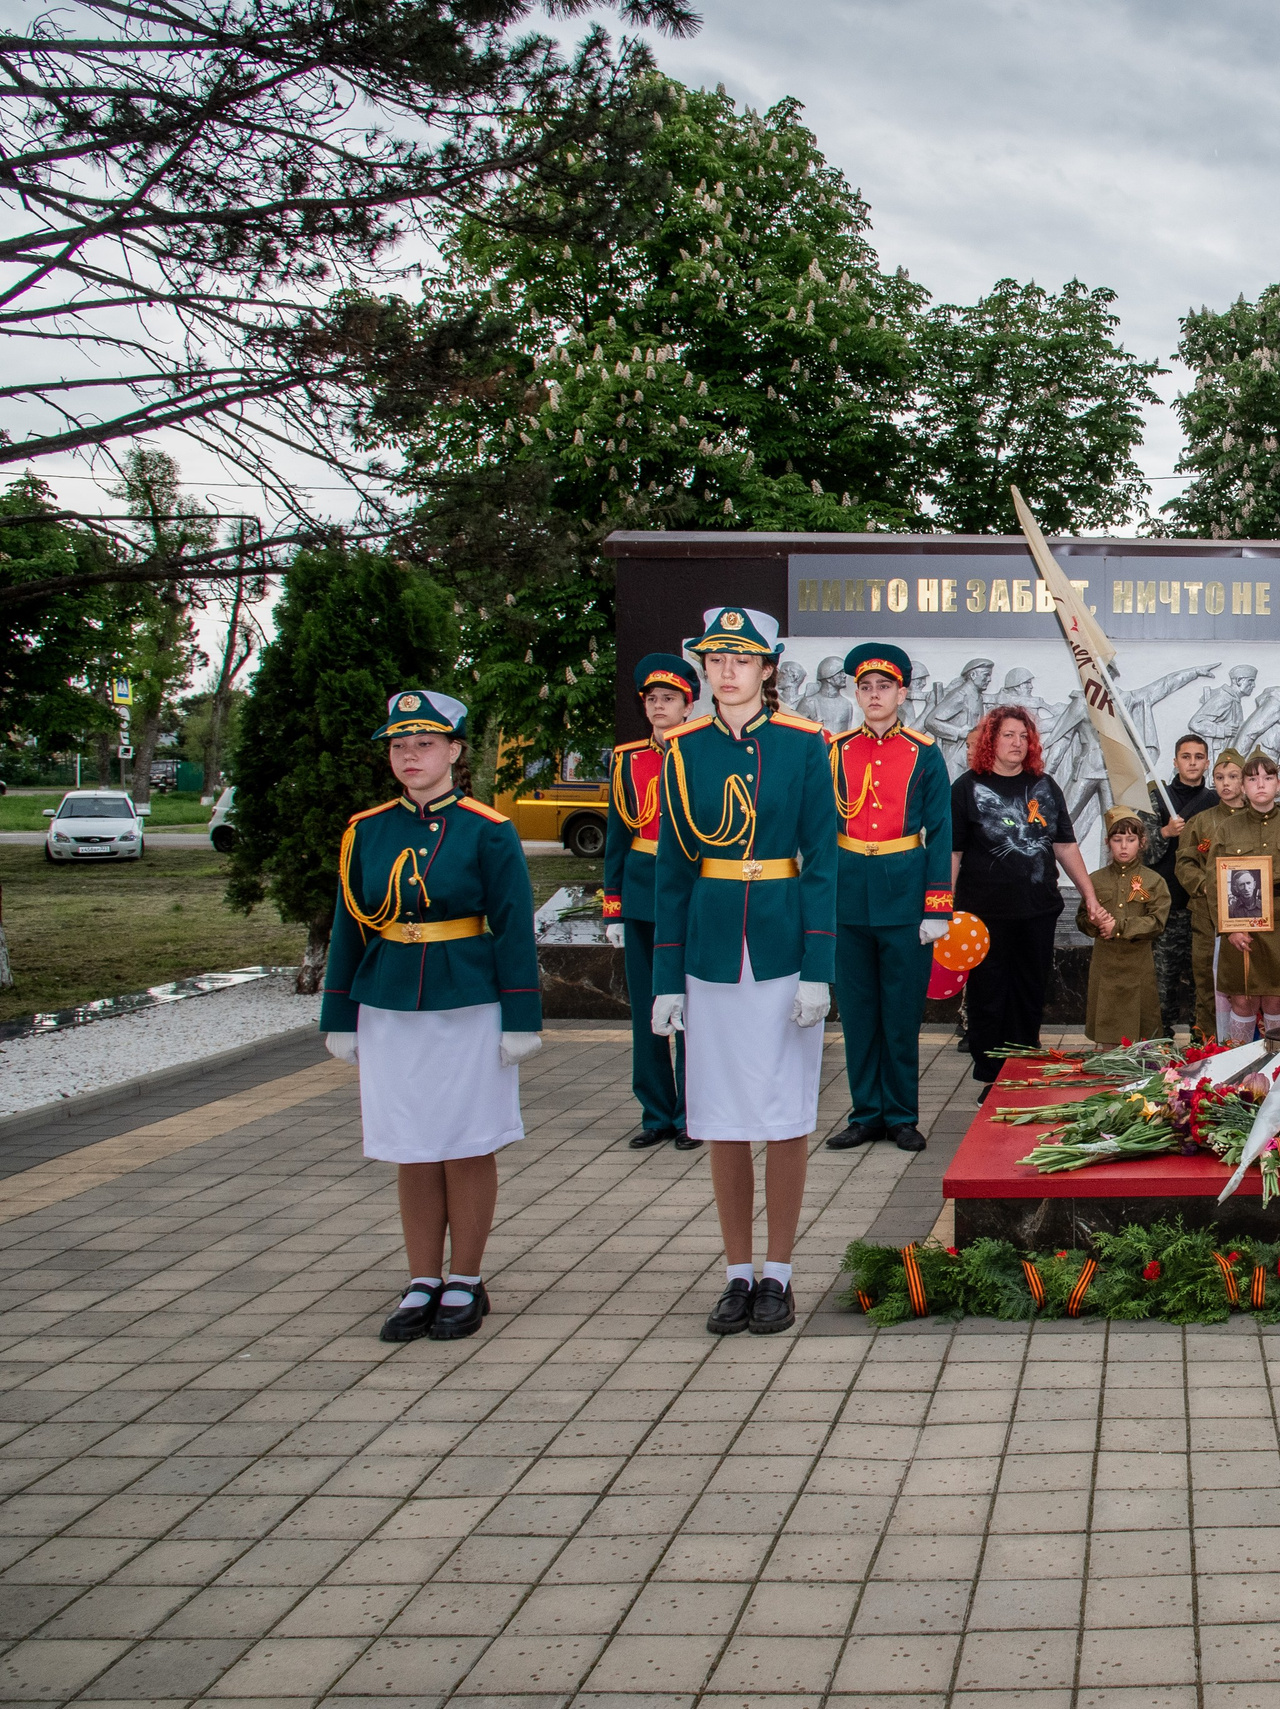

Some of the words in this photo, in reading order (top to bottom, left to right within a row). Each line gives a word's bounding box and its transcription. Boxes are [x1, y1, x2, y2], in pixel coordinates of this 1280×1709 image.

[798, 578, 909, 612] НИКТО
[917, 578, 958, 612] НЕ
[1112, 580, 1226, 615] НИЧТО
[1232, 581, 1271, 615] НЕ
